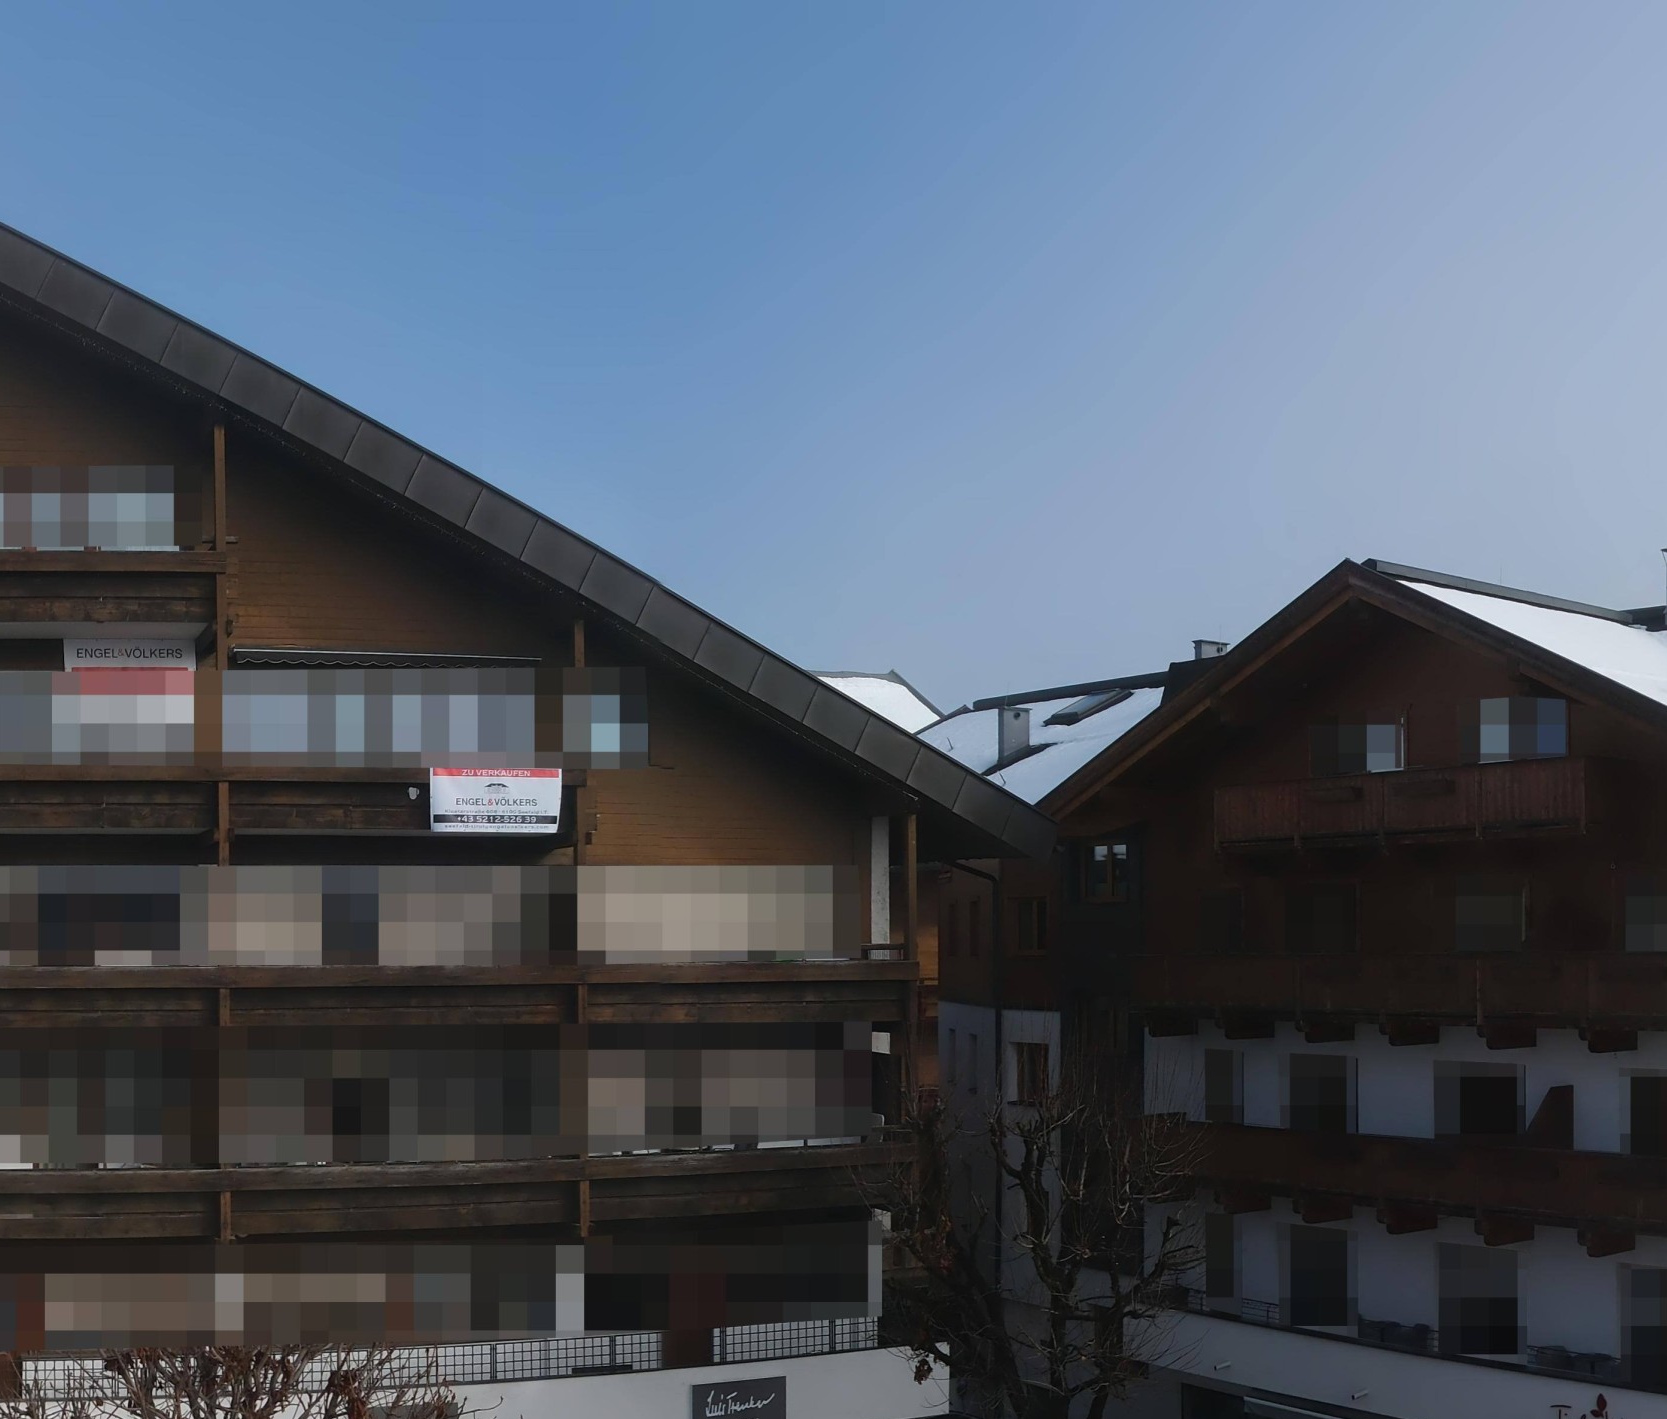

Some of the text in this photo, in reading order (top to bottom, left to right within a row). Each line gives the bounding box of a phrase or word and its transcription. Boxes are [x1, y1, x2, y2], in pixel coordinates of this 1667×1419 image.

[76, 646, 183, 659] ENGEL&VÖLKERS
[476, 769, 531, 777] VERKAUFEN
[455, 797, 538, 806] ENGEL&VÖLKERS
[457, 815, 474, 823] +43
